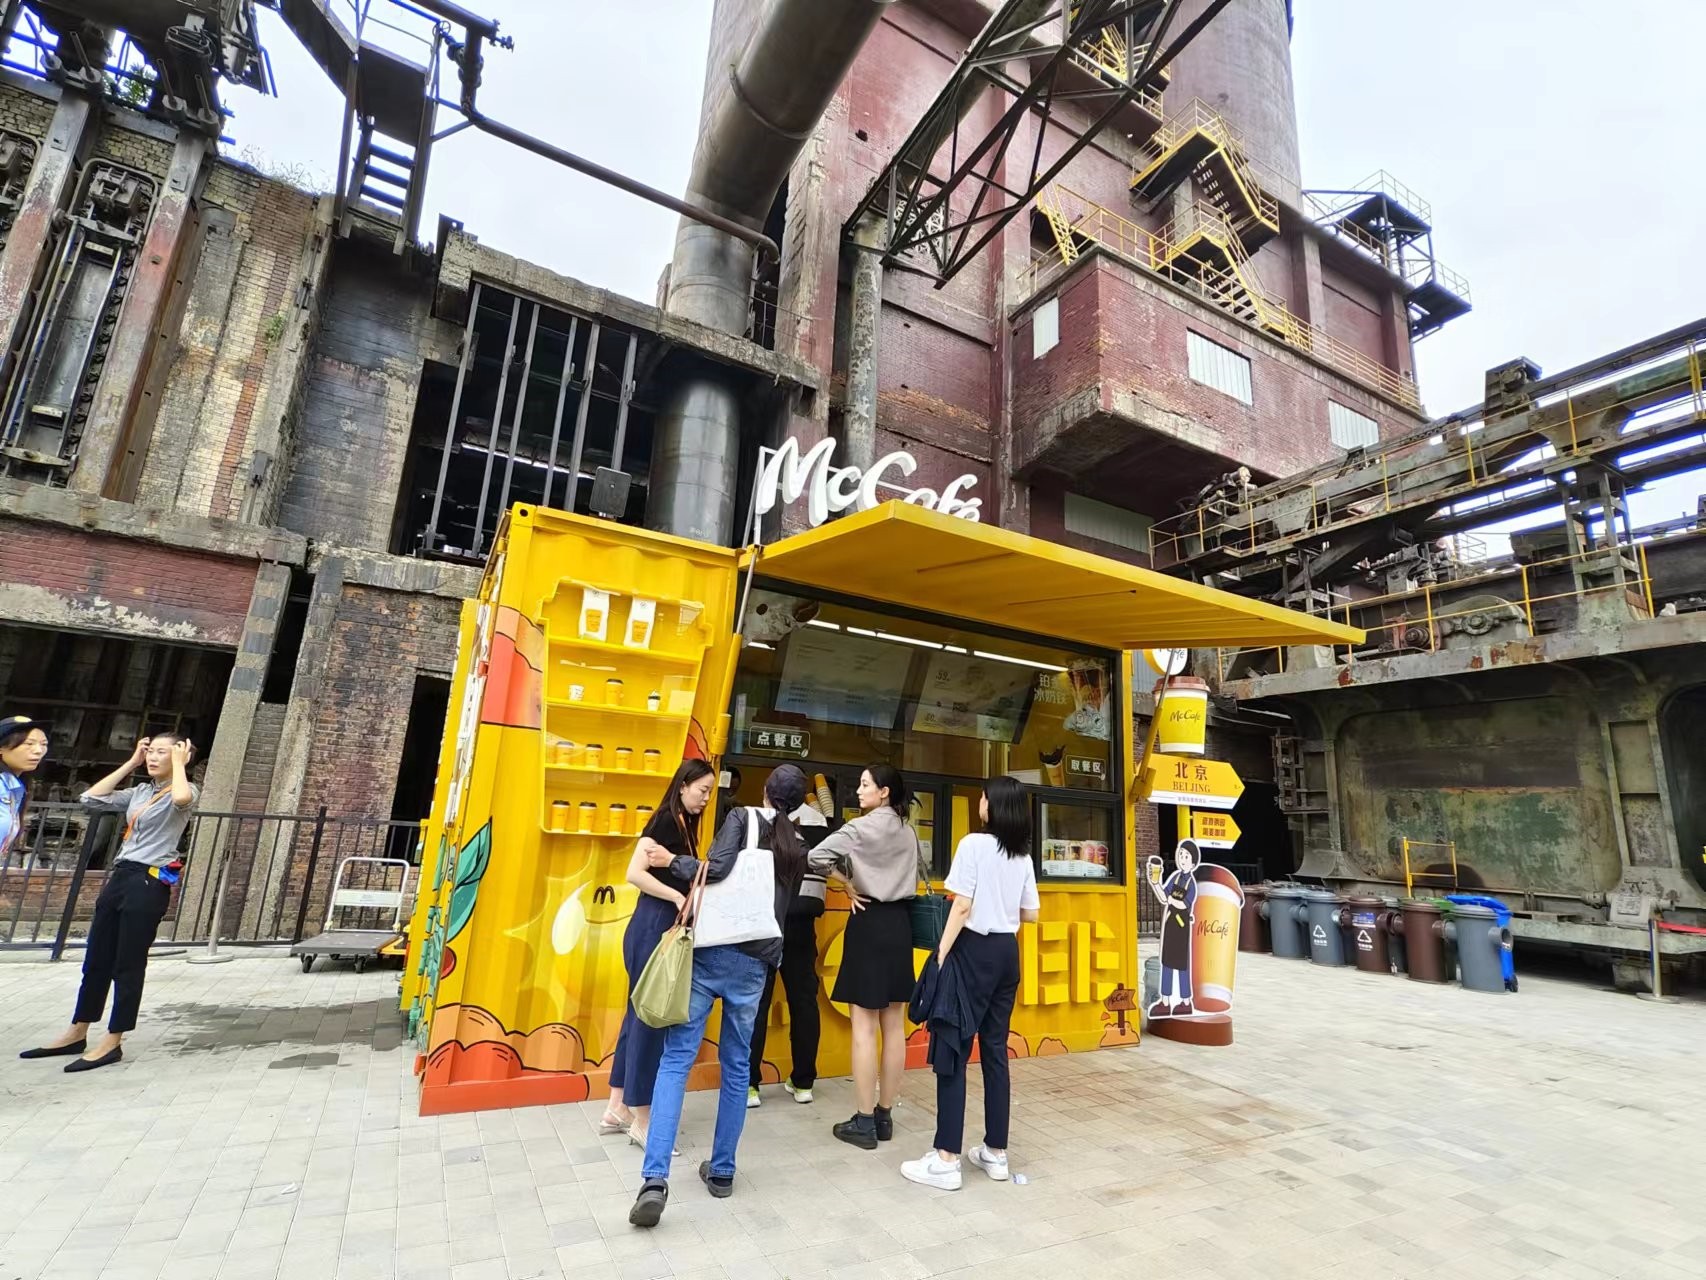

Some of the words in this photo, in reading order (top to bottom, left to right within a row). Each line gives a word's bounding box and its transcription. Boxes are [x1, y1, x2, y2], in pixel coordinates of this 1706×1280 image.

[757, 731, 803, 748] 点餐区
[1174, 761, 1208, 780] 北京
